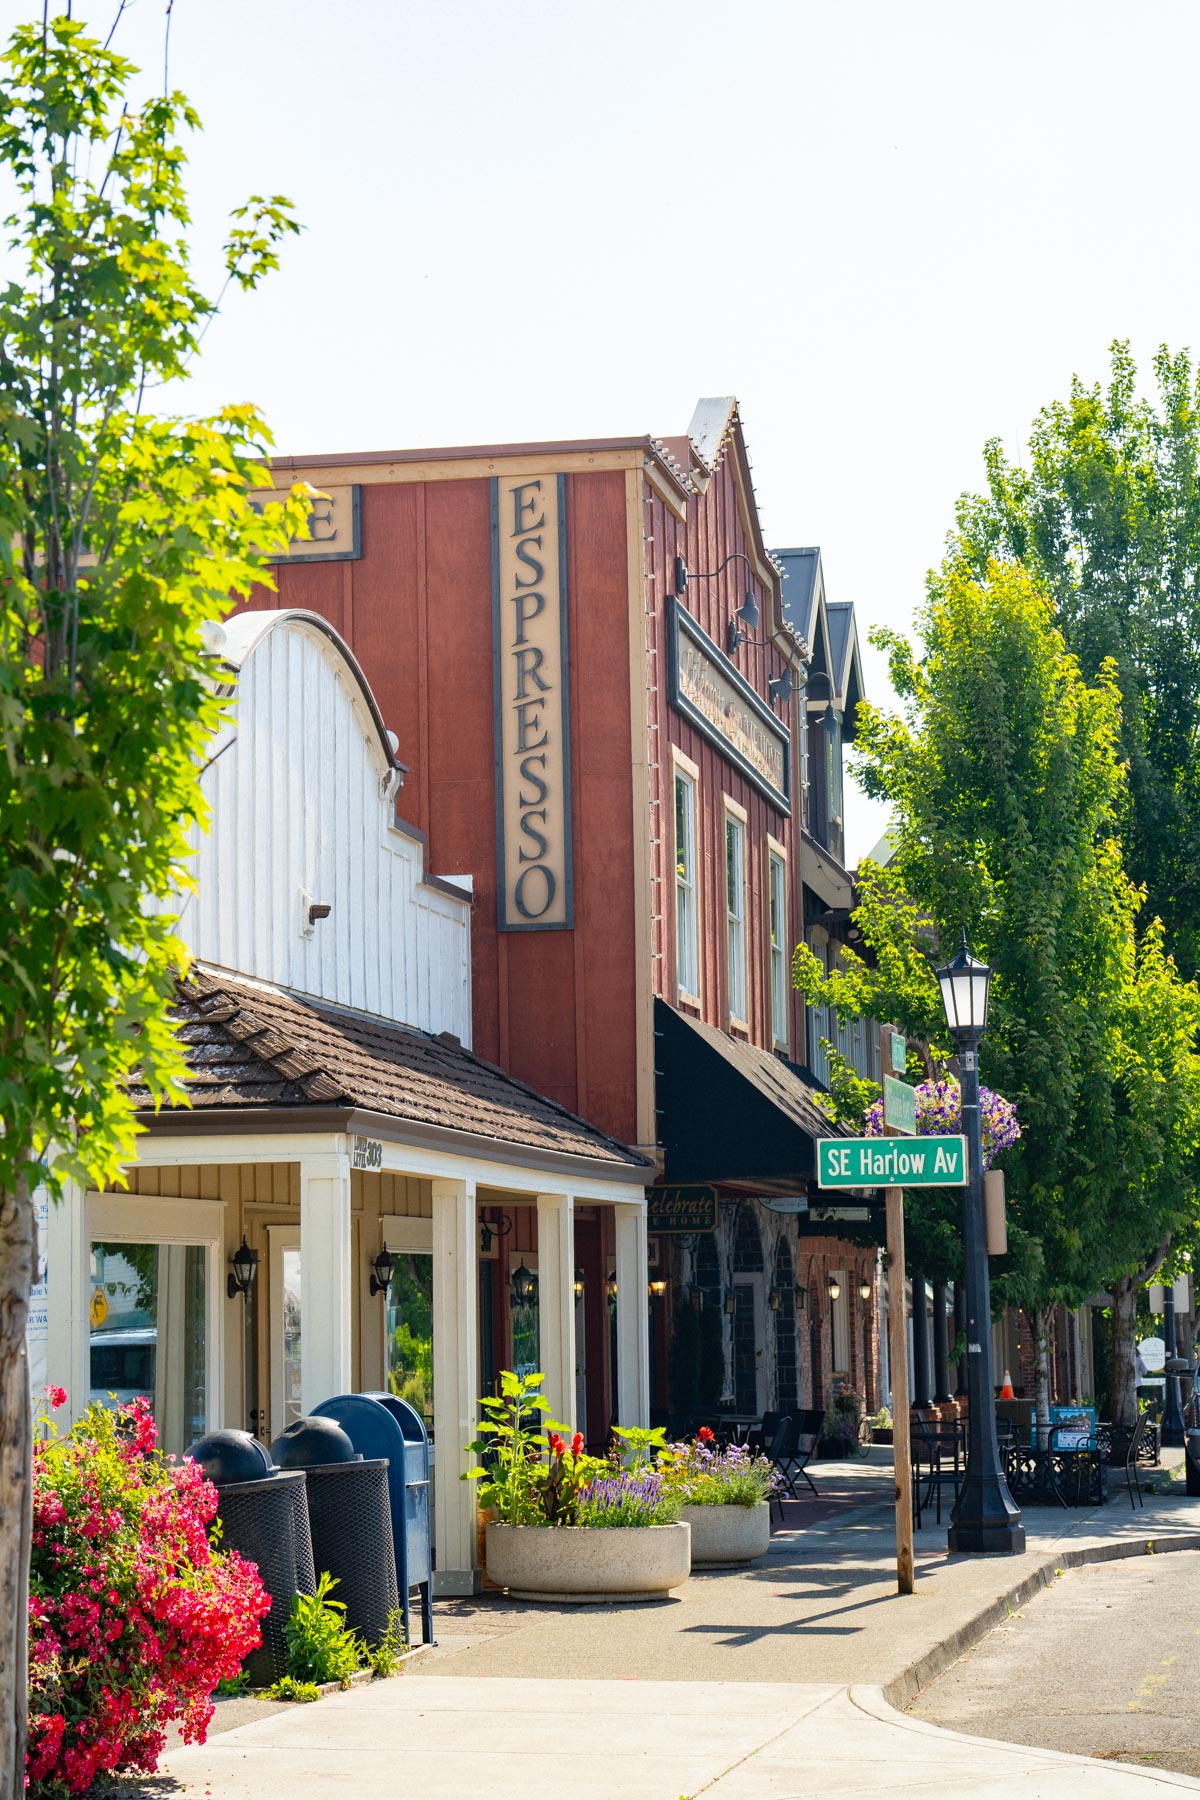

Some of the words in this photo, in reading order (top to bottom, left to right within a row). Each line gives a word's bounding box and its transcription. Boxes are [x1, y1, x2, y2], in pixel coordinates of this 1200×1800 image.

[508, 480, 556, 919] ESPRESSO
[366, 1141, 382, 1168] 303
[827, 1148, 852, 1177] SE
[860, 1147, 926, 1176] Harlow
[933, 1146, 958, 1174] Av
[646, 1189, 712, 1214] elebrate
[669, 1216, 712, 1226] HOME
